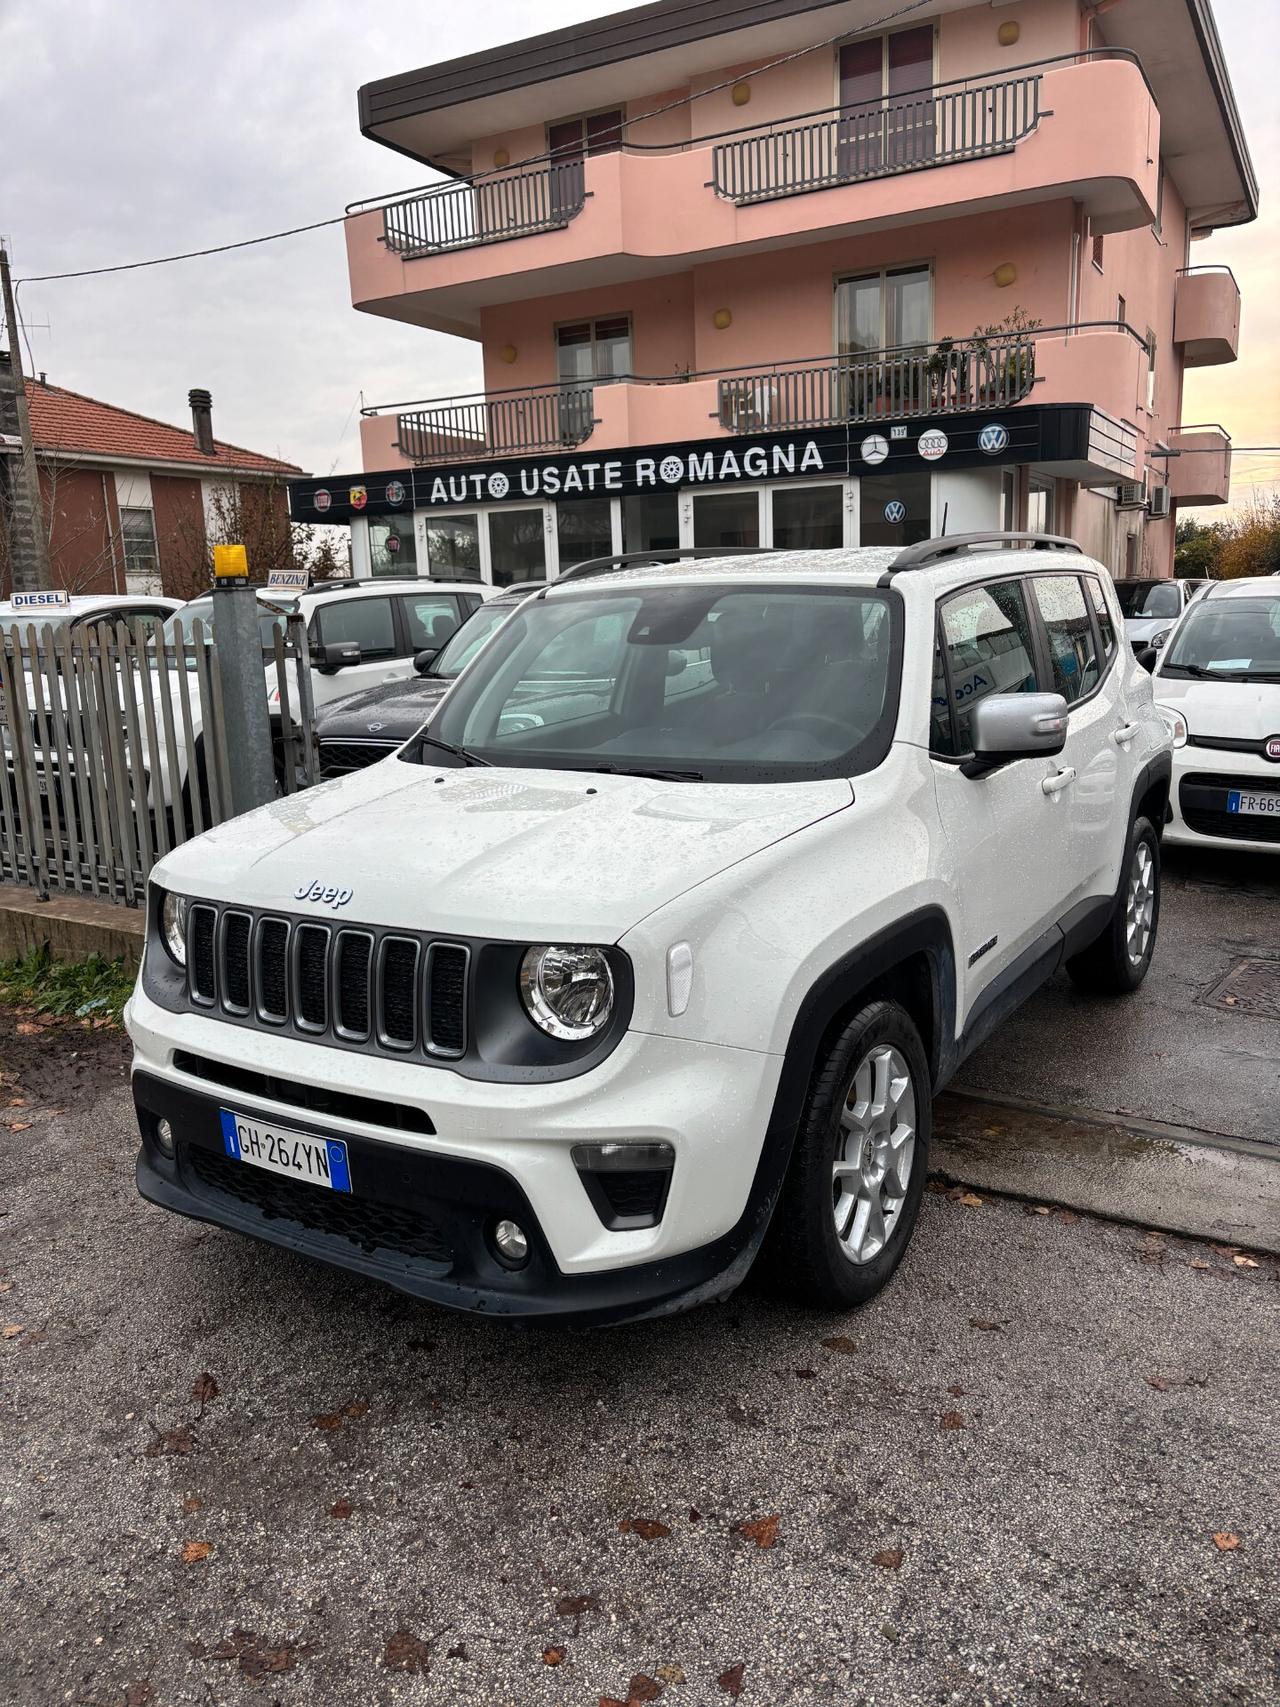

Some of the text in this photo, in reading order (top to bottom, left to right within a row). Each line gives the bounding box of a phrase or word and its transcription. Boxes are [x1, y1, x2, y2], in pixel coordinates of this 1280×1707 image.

[431, 441, 824, 503] AUTO USATE ROMAGNA
[270, 573, 306, 585] BENZINA
[14, 594, 63, 606] DIESEL
[294, 879, 354, 910] Jeep
